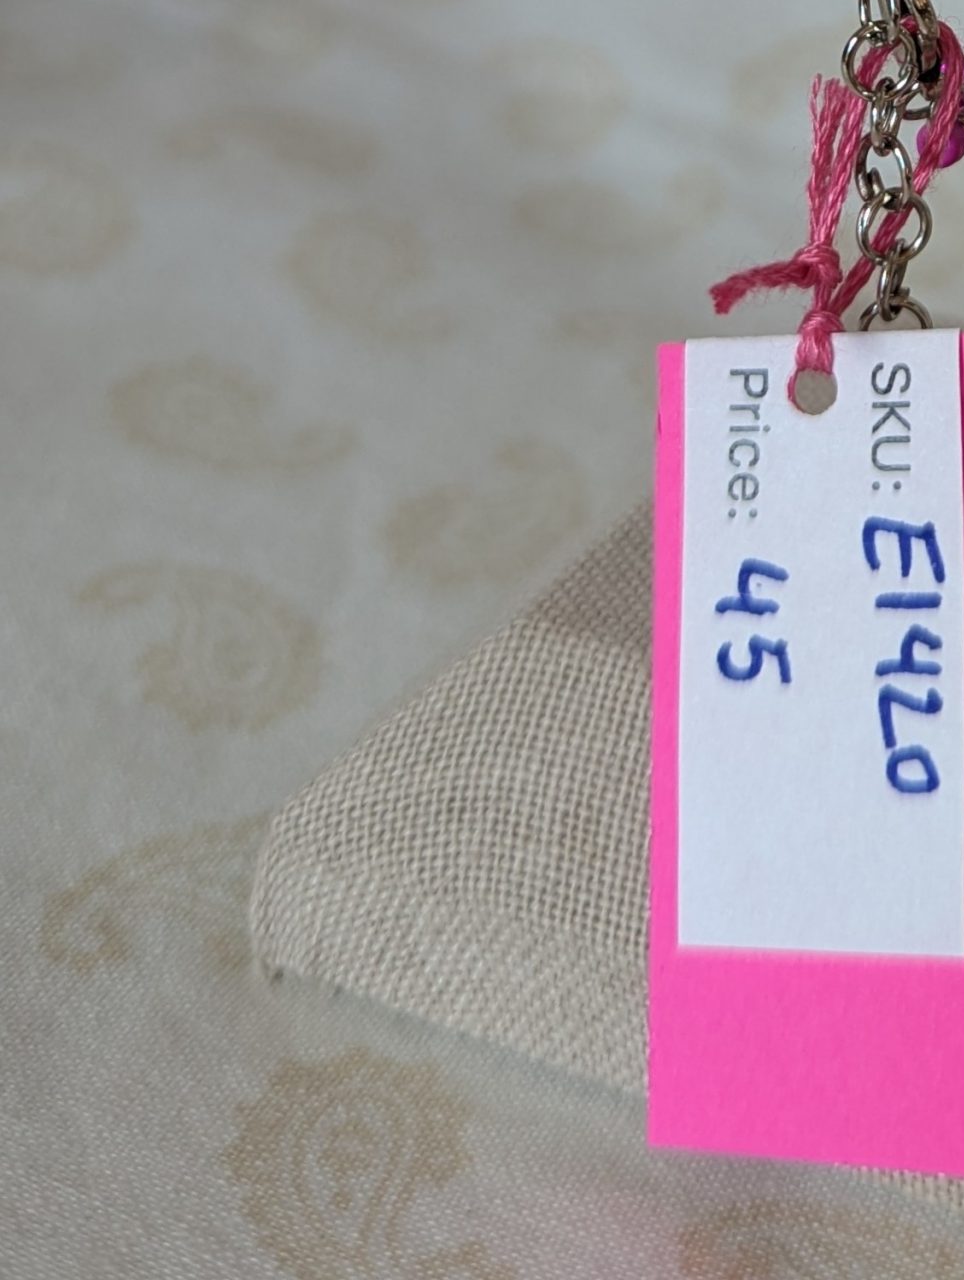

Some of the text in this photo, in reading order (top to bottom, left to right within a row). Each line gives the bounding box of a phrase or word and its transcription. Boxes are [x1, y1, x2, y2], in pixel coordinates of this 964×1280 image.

[714, 368, 792, 686] Price: 45
[862, 362, 946, 795] SKU: E1420
